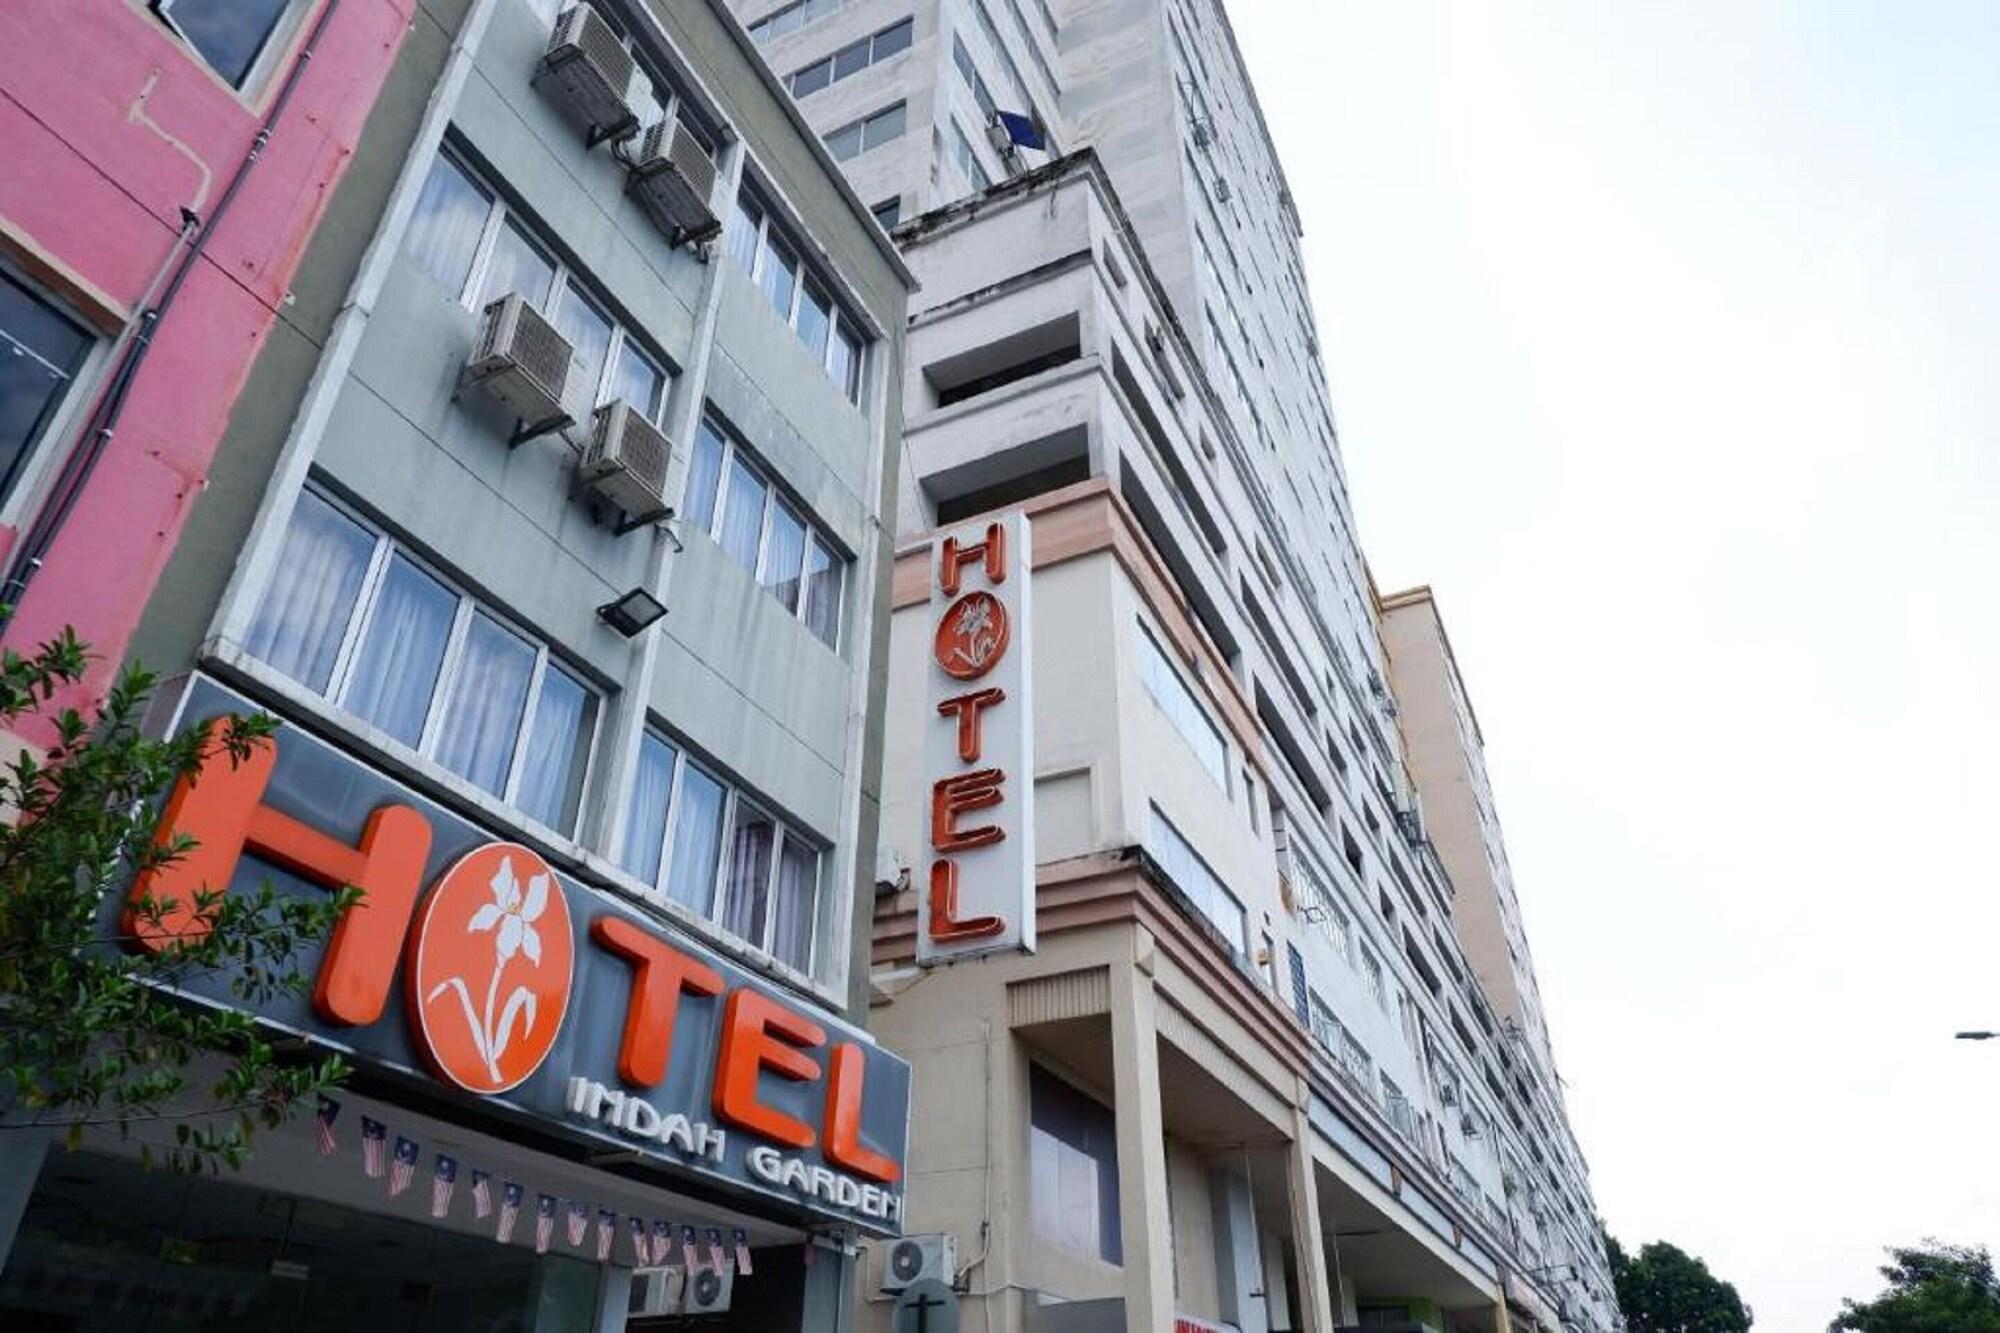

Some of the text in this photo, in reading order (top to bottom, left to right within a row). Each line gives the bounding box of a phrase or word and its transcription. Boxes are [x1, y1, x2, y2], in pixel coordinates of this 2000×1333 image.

[928, 521, 1010, 944] HOTEL
[121, 714, 901, 1184] HOTEL
[746, 1145, 901, 1223] GARDEN
